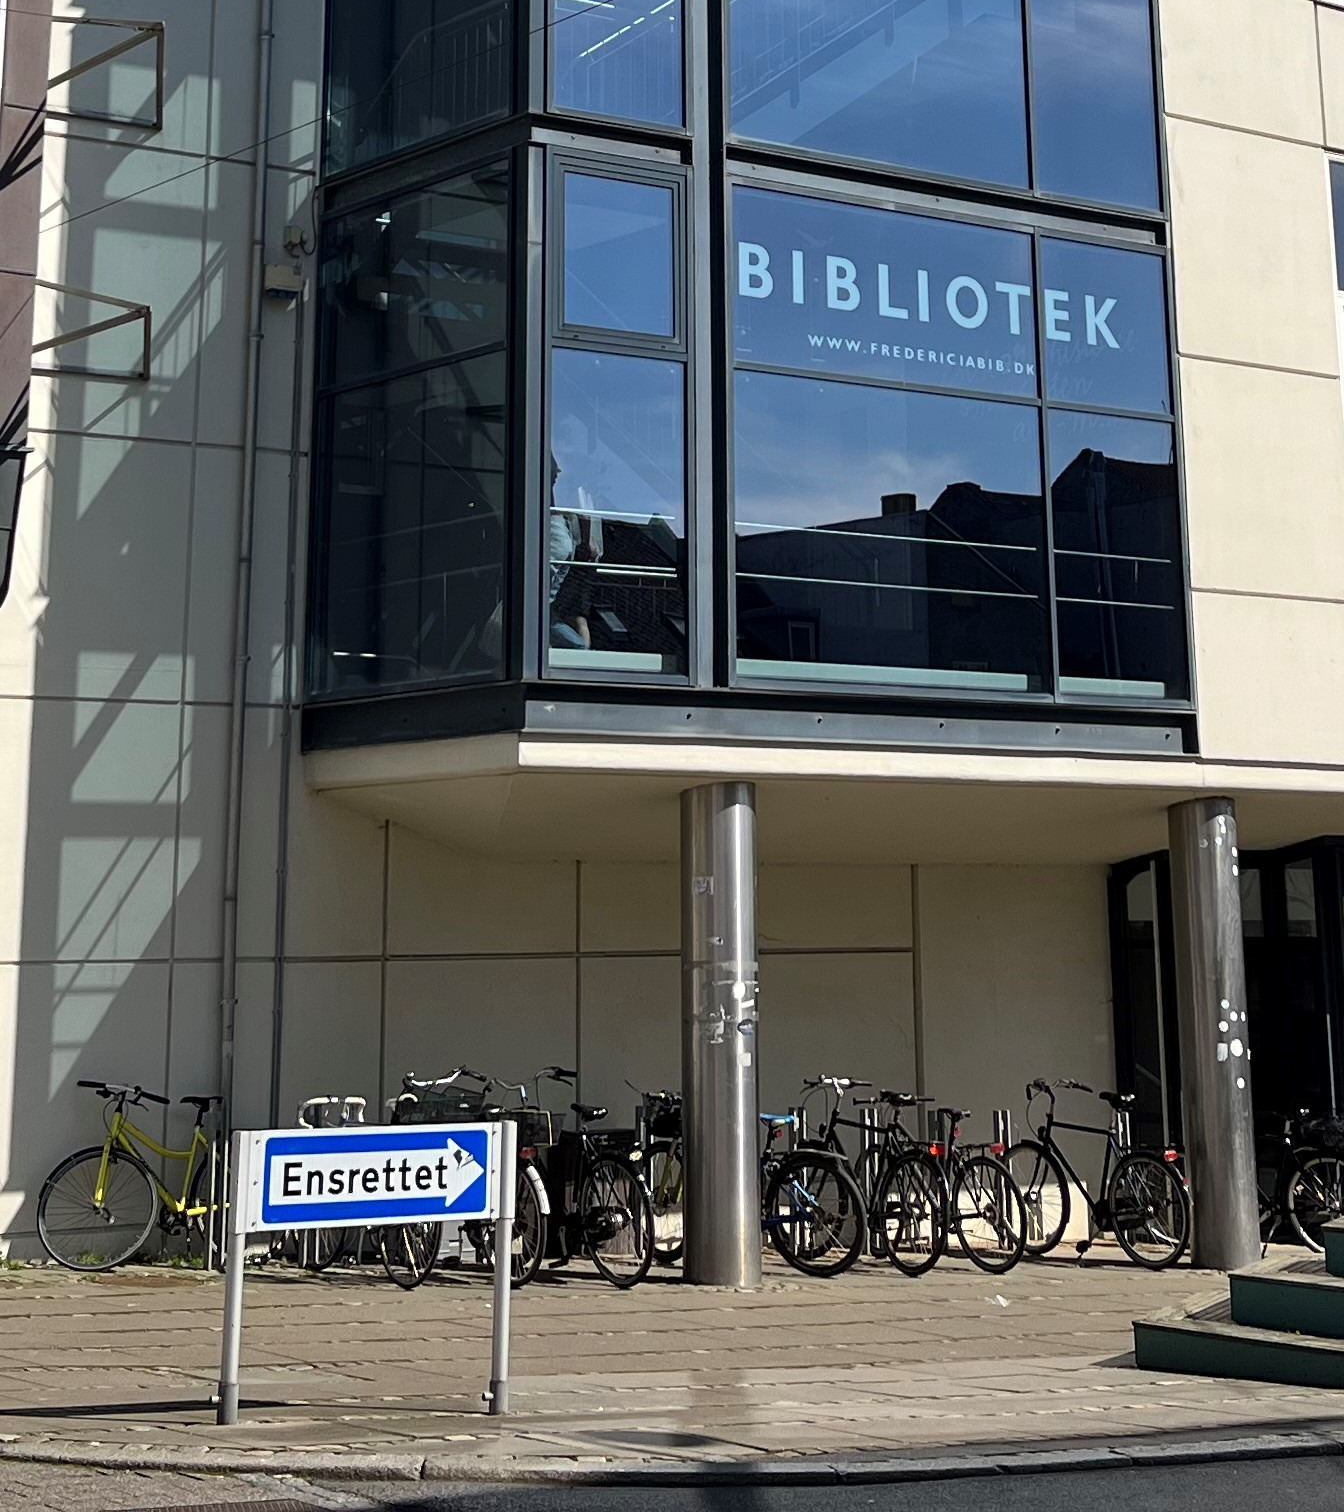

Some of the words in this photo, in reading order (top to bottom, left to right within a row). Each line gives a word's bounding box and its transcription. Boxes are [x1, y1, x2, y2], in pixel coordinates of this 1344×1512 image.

[738, 242, 1120, 349] BIBLIOTEK
[808, 334, 1035, 376] WWW.FREDERICIABIB.DK
[282, 1156, 448, 1197] Ensrettet
